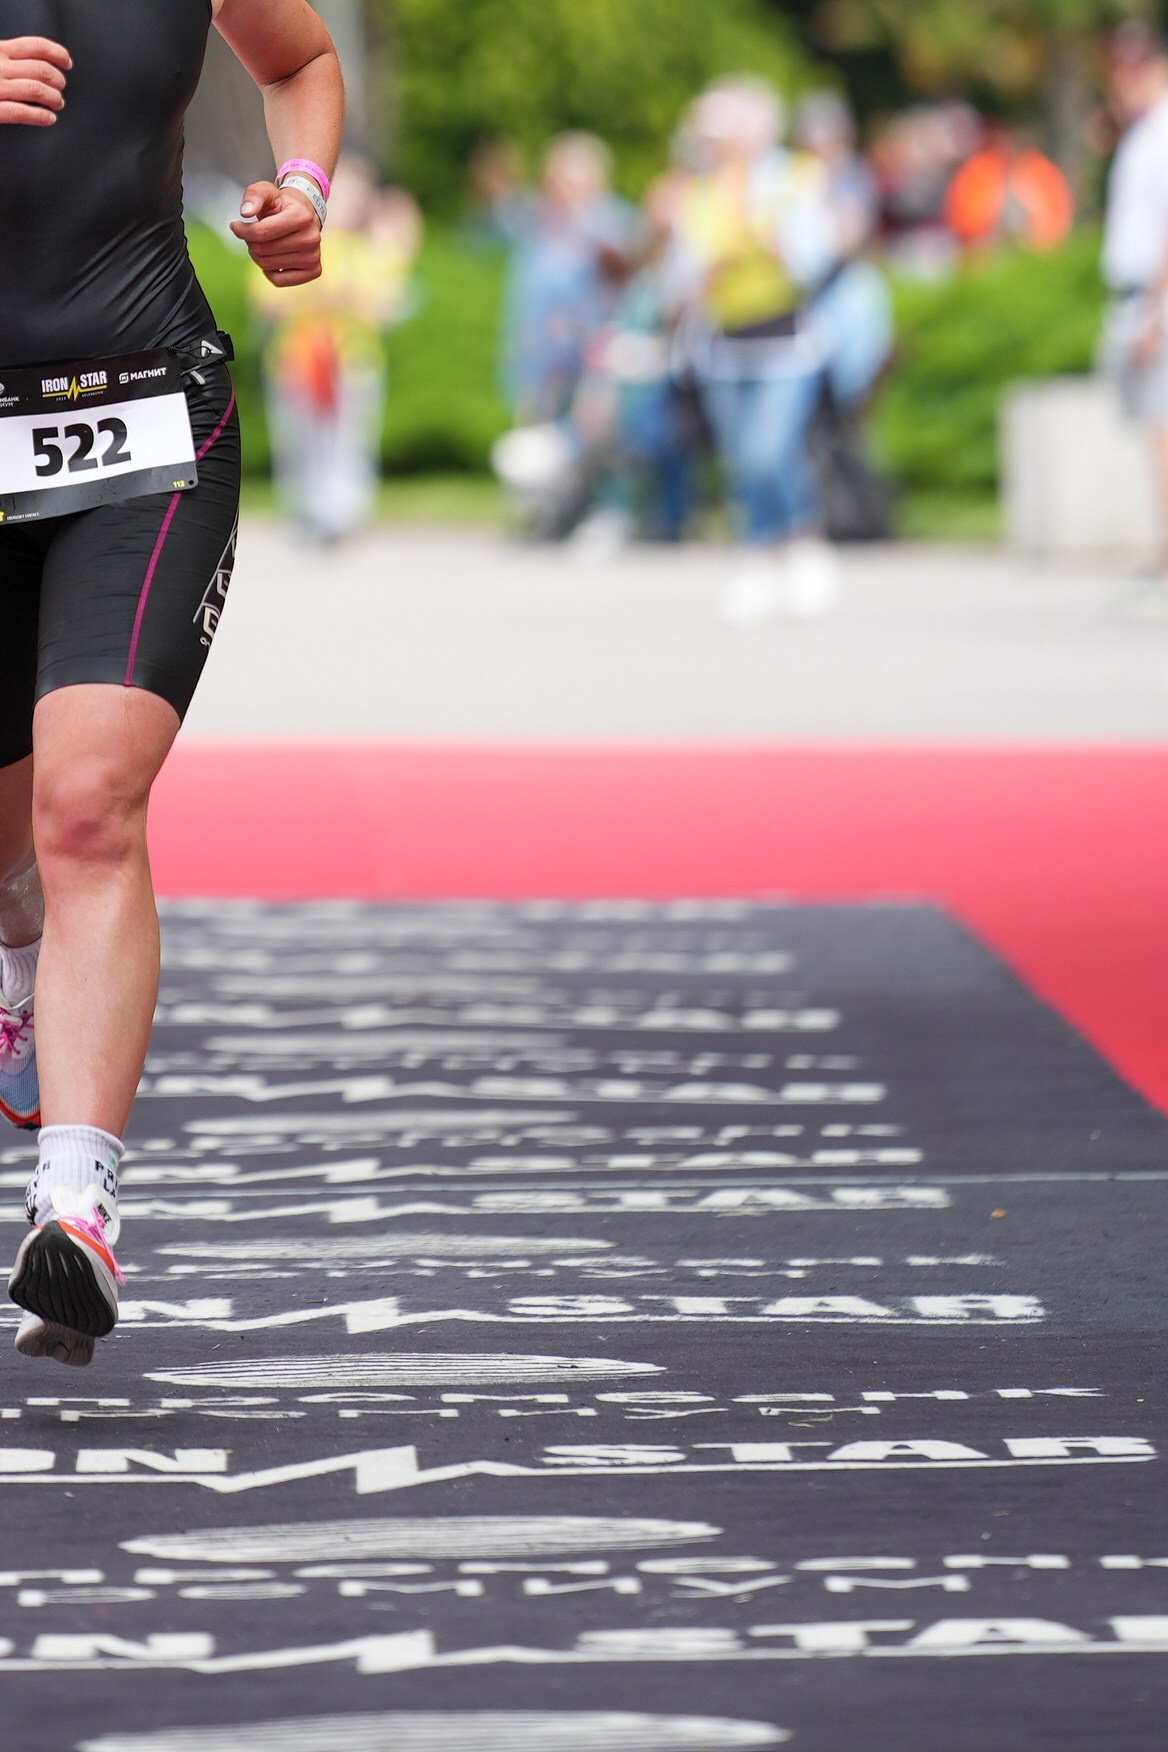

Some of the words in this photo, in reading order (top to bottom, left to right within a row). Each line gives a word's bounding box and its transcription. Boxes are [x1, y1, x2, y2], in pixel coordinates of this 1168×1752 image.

[41, 377, 69, 394] IRON
[79, 370, 108, 388] STAR
[129, 367, 167, 382] МАГНИТ
[32, 416, 132, 478] 522
[173, 479, 185, 488] 113
[97, 1203, 113, 1224] NIKE
[506, 1293, 1045, 1319] STAR
[540, 1436, 1157, 1466] STAR
